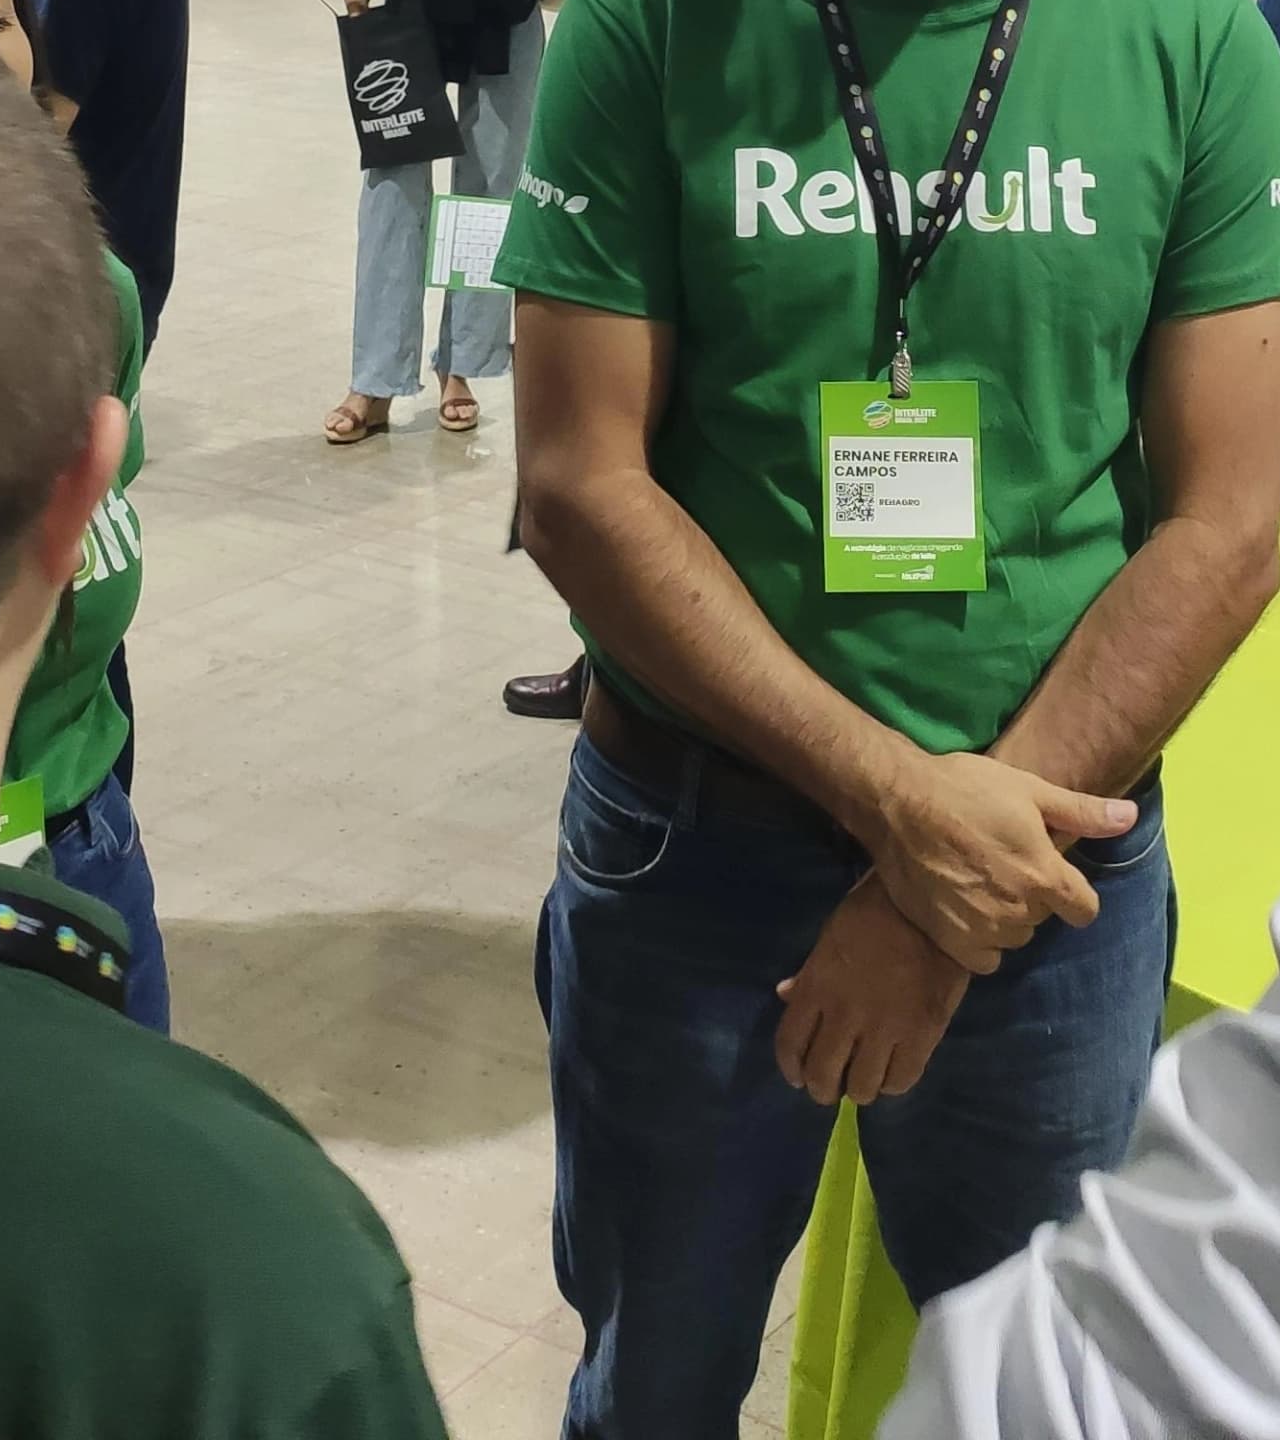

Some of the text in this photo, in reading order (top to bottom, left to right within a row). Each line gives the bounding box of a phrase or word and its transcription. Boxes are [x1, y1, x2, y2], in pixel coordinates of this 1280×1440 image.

[834, 450, 958, 463] ERNANE FERREIRA
[834, 465, 897, 478] CAMPOS
